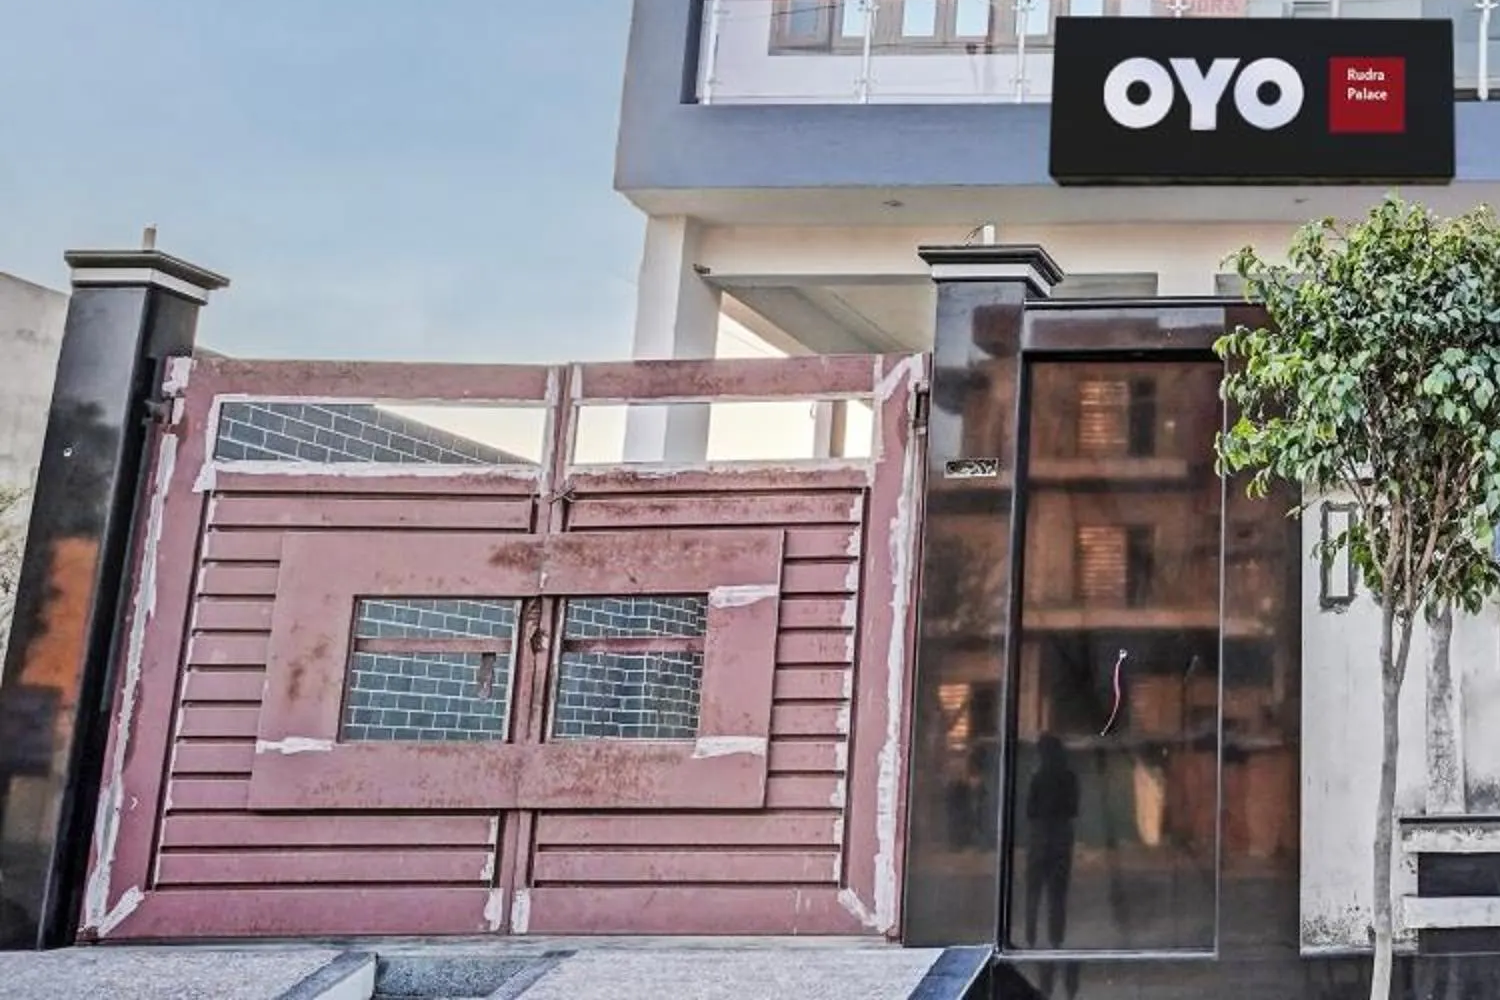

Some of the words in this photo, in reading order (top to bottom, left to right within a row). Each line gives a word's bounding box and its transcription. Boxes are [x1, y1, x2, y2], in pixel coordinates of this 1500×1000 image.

[1347, 67, 1385, 81] Rudra
[1103, 56, 1305, 131] OYO
[1347, 87, 1388, 101] Palace
